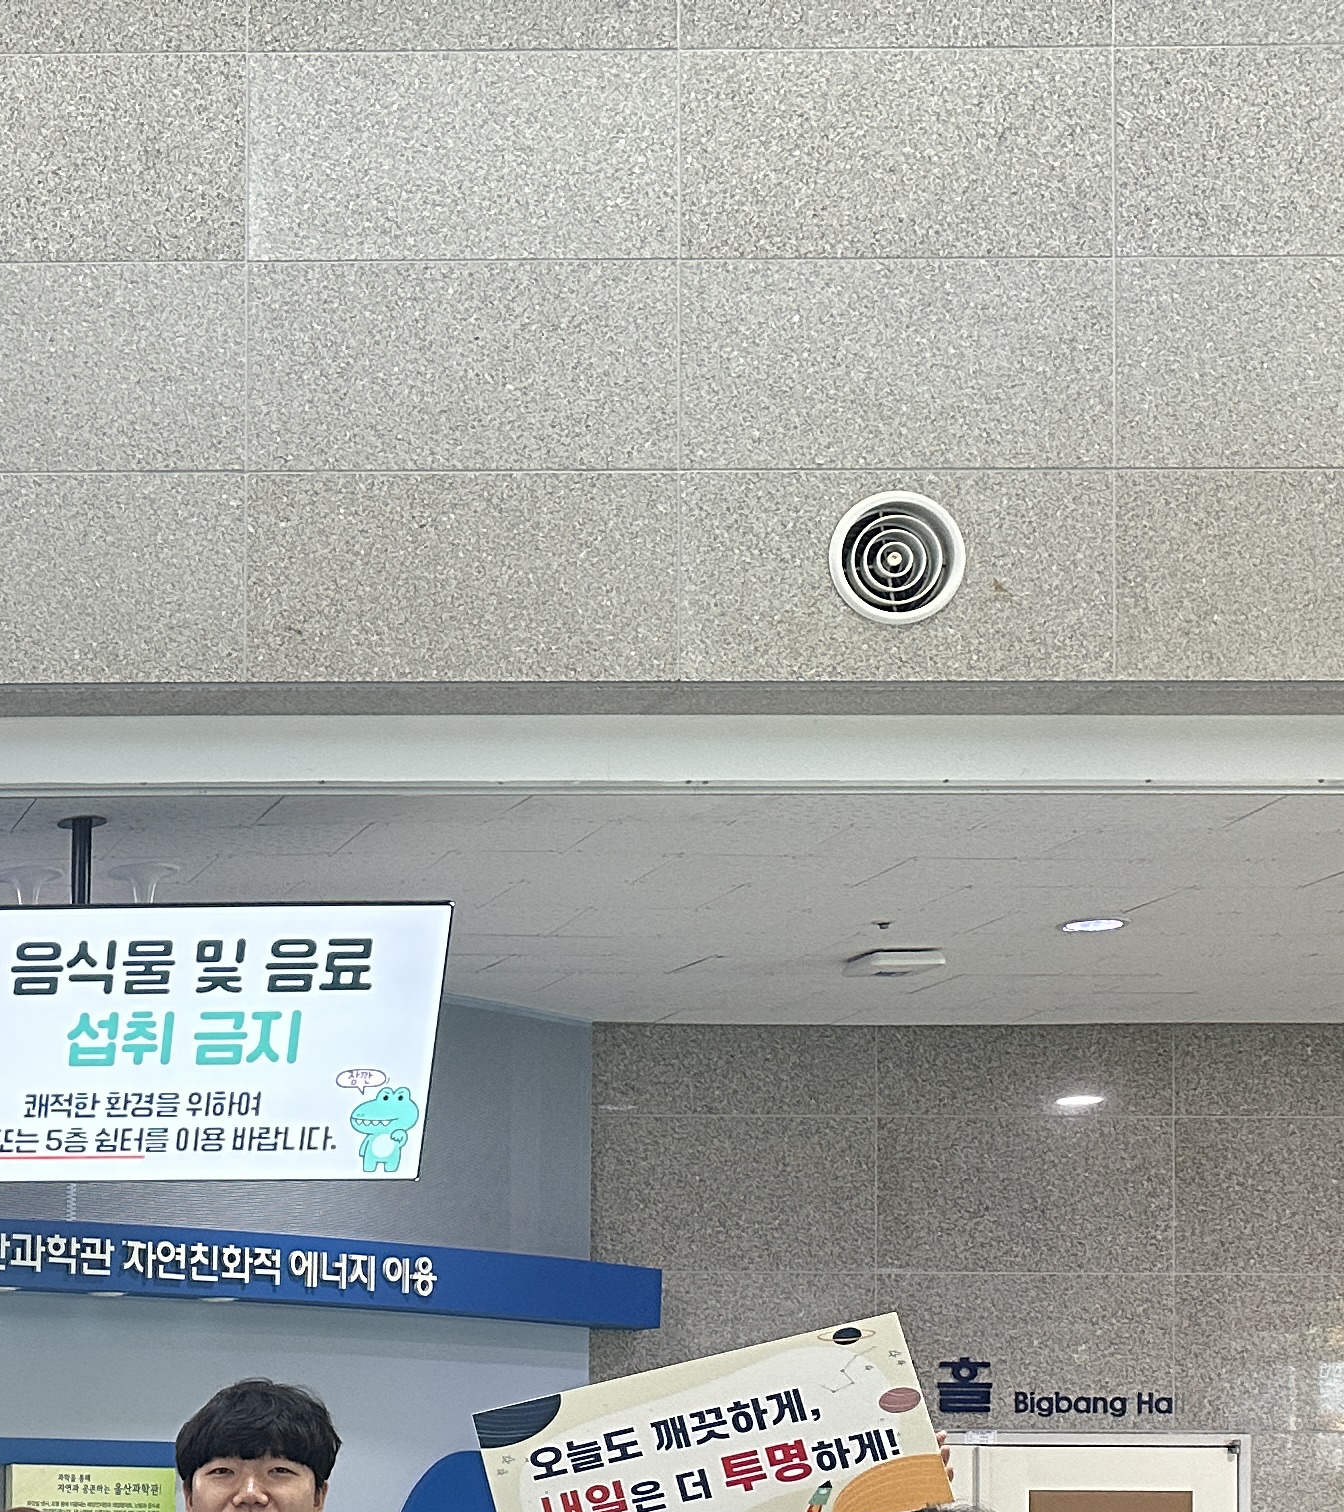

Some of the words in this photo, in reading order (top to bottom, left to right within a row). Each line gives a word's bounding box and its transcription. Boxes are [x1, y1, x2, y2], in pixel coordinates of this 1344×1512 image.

[11, 937, 176, 995] 음식물
[196, 938, 243, 994] 및
[265, 937, 373, 994] 음료
[67, 1011, 175, 1067] 섭취
[194, 1010, 302, 1066] 금지
[23, 1092, 101, 1119] 쾌적한
[104, 1091, 181, 1119] 환경을
[186, 1090, 263, 1117] 위하여
[347, 1070, 374, 1086] 잠깐
[45, 1128, 90, 1154] 5층
[94, 1127, 170, 1153] 쉼터를
[175, 1127, 226, 1153] 이용
[231, 1125, 338, 1153] 바랍니다.
[122, 1239, 282, 1287] 자연친화적
[289, 1249, 377, 1293] 에너지
[382, 1255, 438, 1297] 이용
[937, 1356, 993, 1413] 홀
[1014, 1391, 1128, 1418] Bigbang
[1137, 1392, 1174, 1414] Ha
[529, 1427, 644, 1481] 오늘도
[650, 1388, 823, 1452] 깨끗하게,
[675, 1468, 713, 1503] 더
[720, 1428, 902, 1493] 투명하게!
